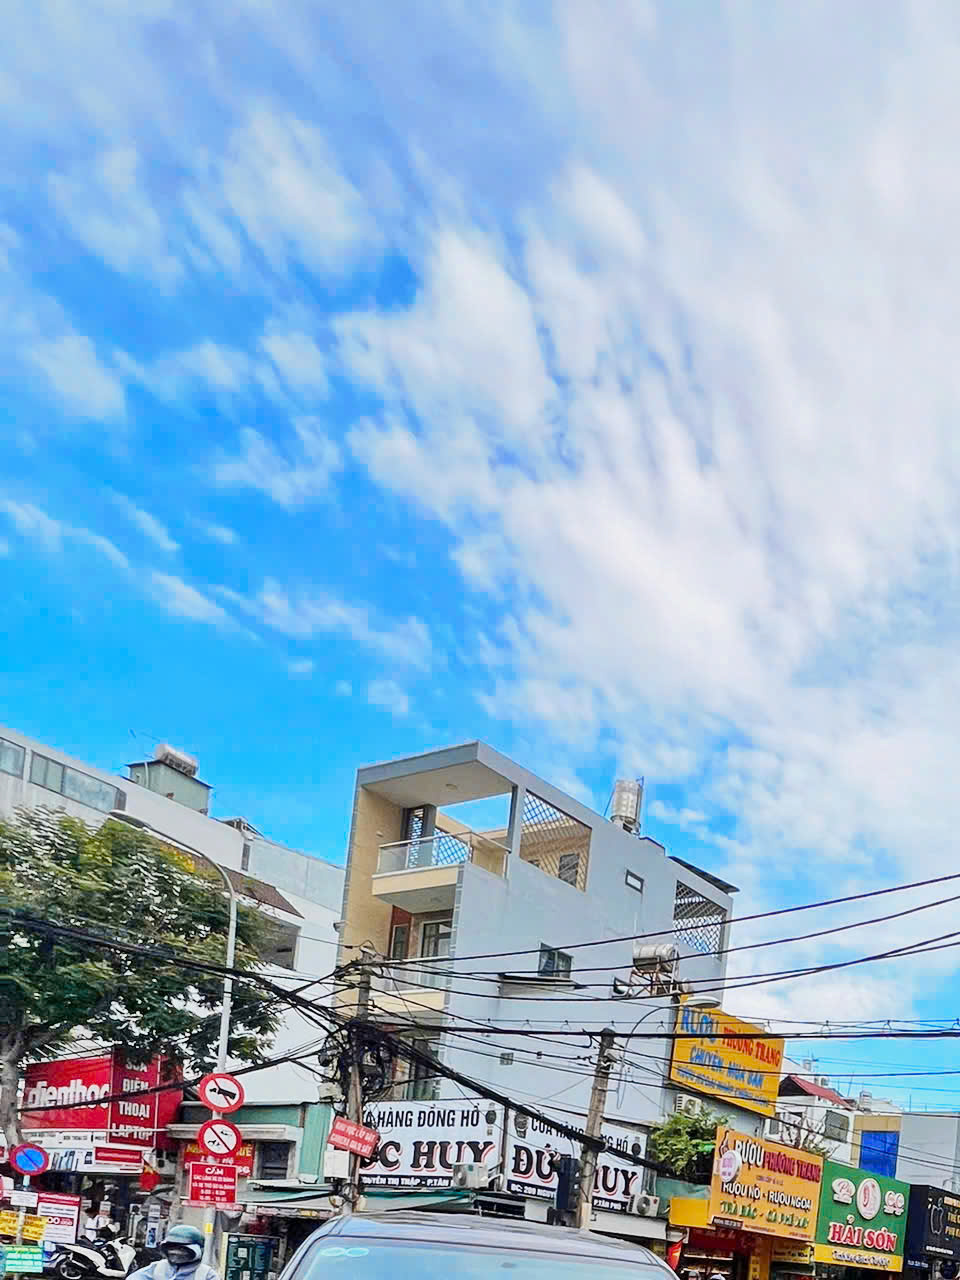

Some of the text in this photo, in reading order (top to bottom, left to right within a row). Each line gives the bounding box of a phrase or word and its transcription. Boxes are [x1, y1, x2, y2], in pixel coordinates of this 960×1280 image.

[377, 1107, 414, 1128] HÀNG
[112, 1122, 153, 1141] LAPTOP
[410, 1140, 497, 1173] HUY
[829, 1214, 864, 1247] HẢI
[864, 1227, 897, 1252] SƠN
